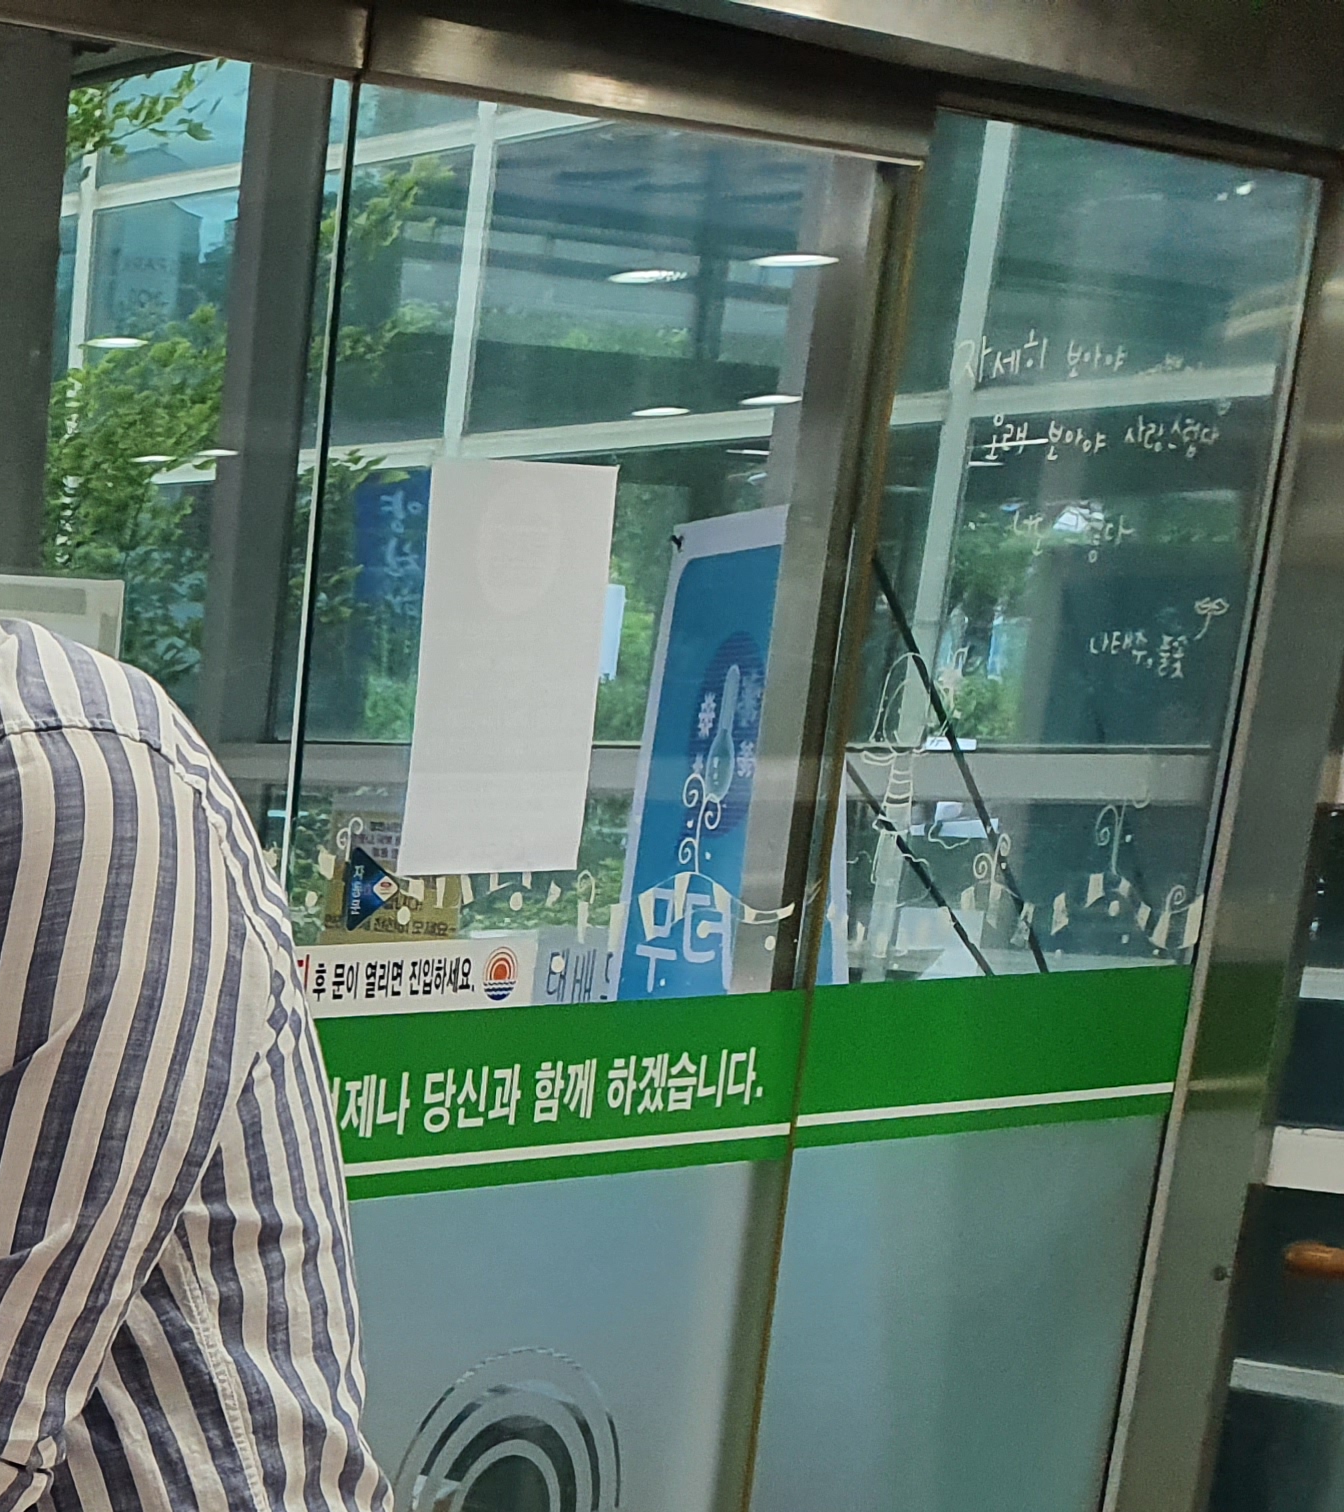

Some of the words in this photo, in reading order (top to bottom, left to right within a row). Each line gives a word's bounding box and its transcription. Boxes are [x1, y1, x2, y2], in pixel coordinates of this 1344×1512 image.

[957, 329, 1047, 382] 자세히
[1067, 339, 1127, 378] 보아야
[1048, 421, 1107, 460] 보아야
[312, 963, 326, 1002] 후
[332, 961, 359, 1000] 문이
[365, 959, 403, 999] 열리면
[409, 957, 475, 996] 진입하세요.
[329, 1072, 410, 1138] 제나
[423, 1064, 520, 1133] 당신과
[533, 1058, 597, 1123] 함께
[607, 1047, 763, 1116] 하겠습니다.
